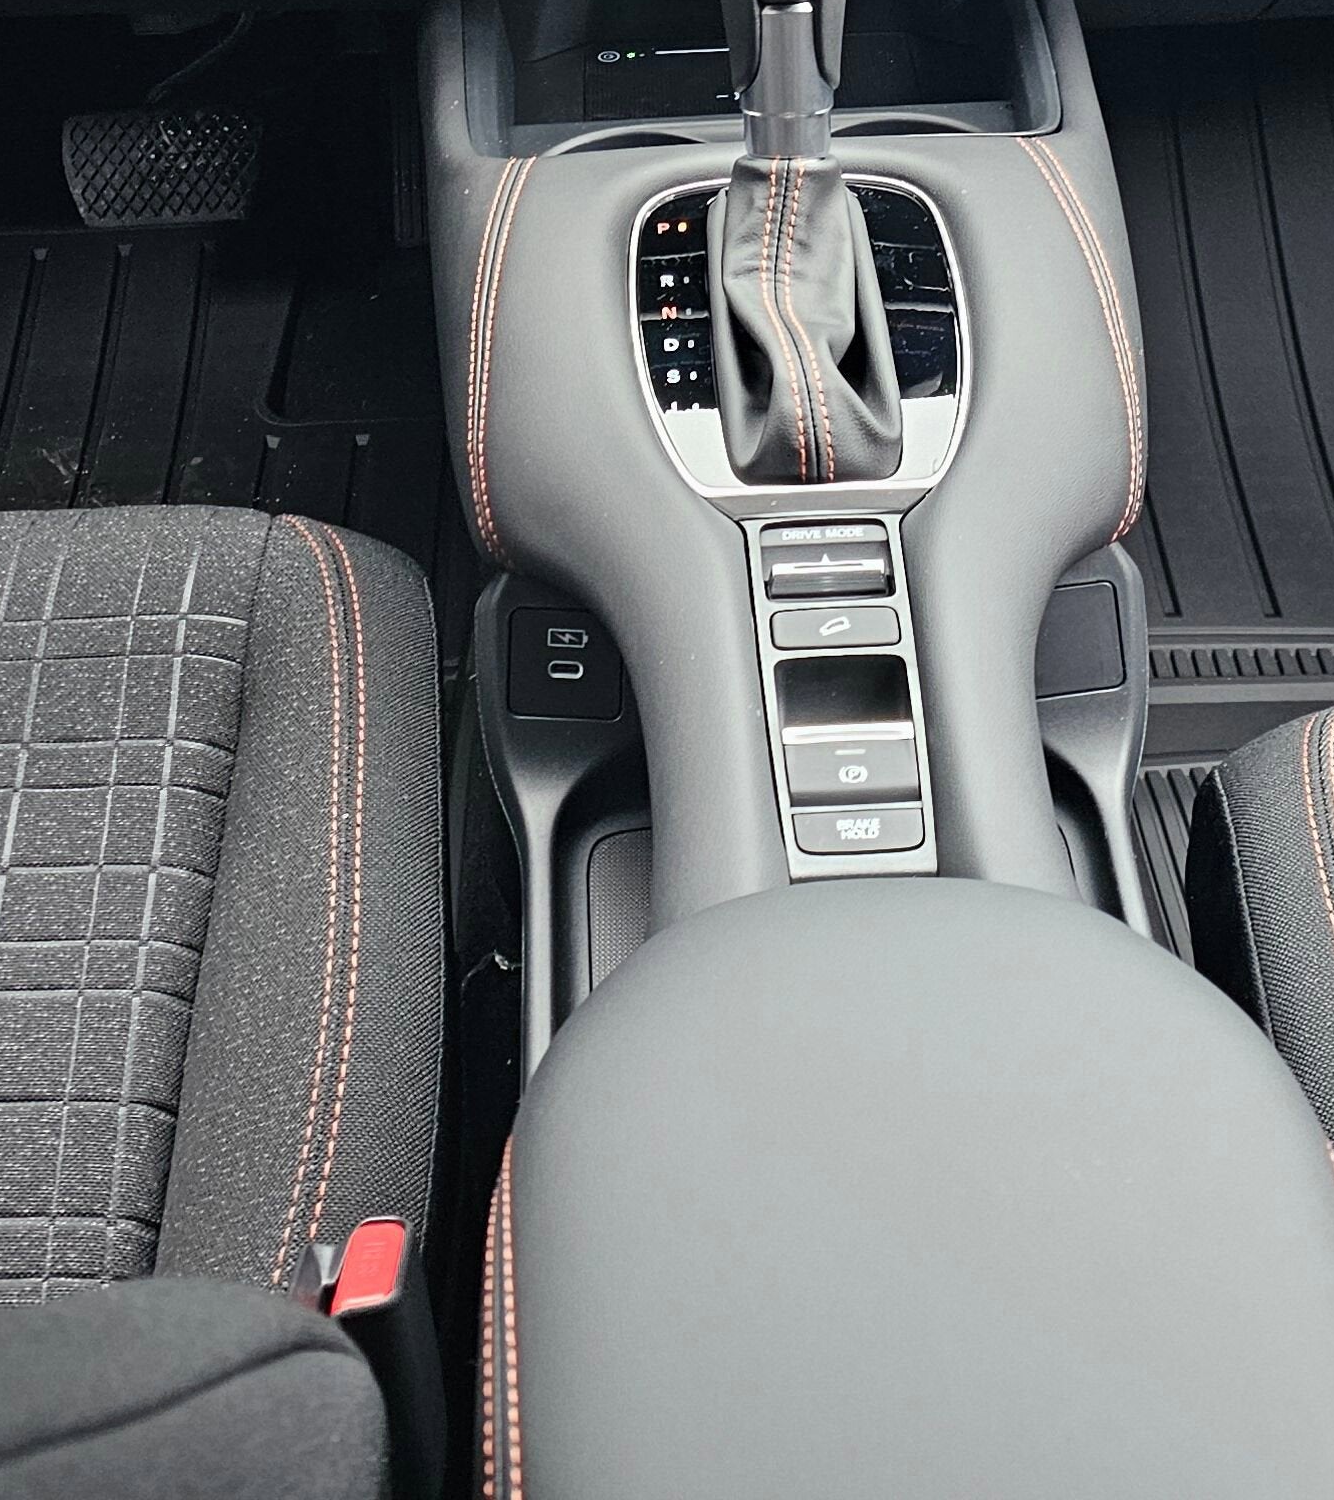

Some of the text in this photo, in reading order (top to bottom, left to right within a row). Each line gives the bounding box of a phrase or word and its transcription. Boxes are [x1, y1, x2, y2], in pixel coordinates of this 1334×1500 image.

[657, 222, 670, 235] P
[660, 274, 674, 288] R
[661, 306, 677, 319] N
[663, 338, 680, 352] D
[666, 369, 681, 384] S
[782, 527, 864, 541] DRIVE MODE
[836, 818, 881, 831] BRAKE
[840, 829, 880, 840] HOLD
